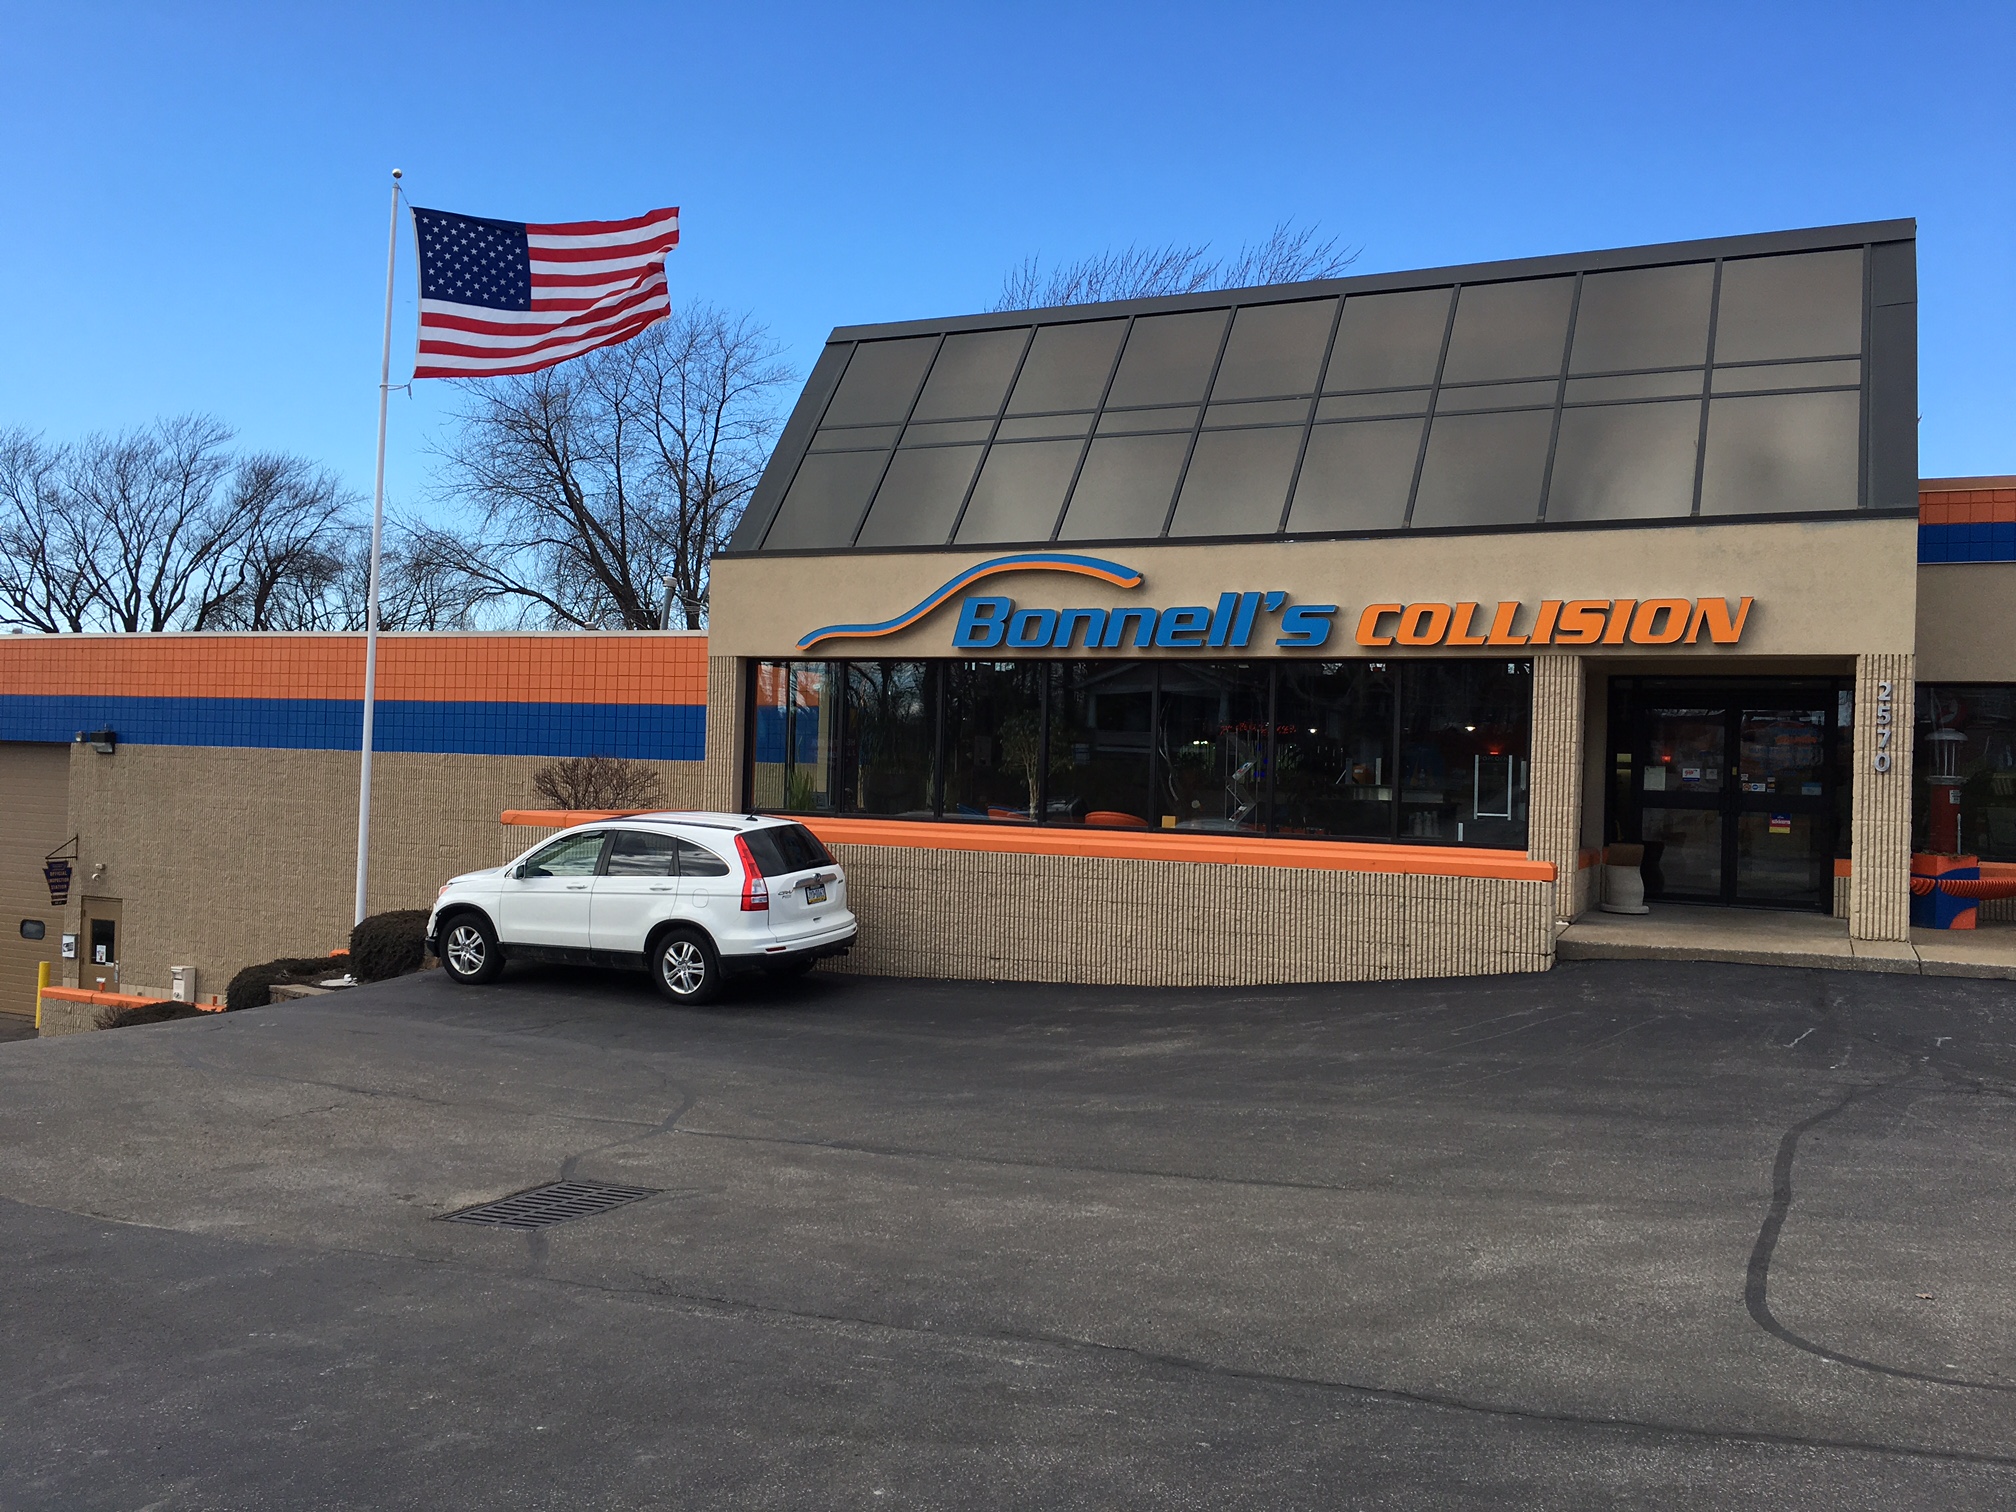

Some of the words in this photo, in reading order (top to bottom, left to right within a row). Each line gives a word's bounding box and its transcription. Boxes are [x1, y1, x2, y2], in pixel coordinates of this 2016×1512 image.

[952, 590, 1337, 649] Bonnell's
[1355, 596, 1755, 647] COLLISION
[1874, 682, 1891, 772] 2570
